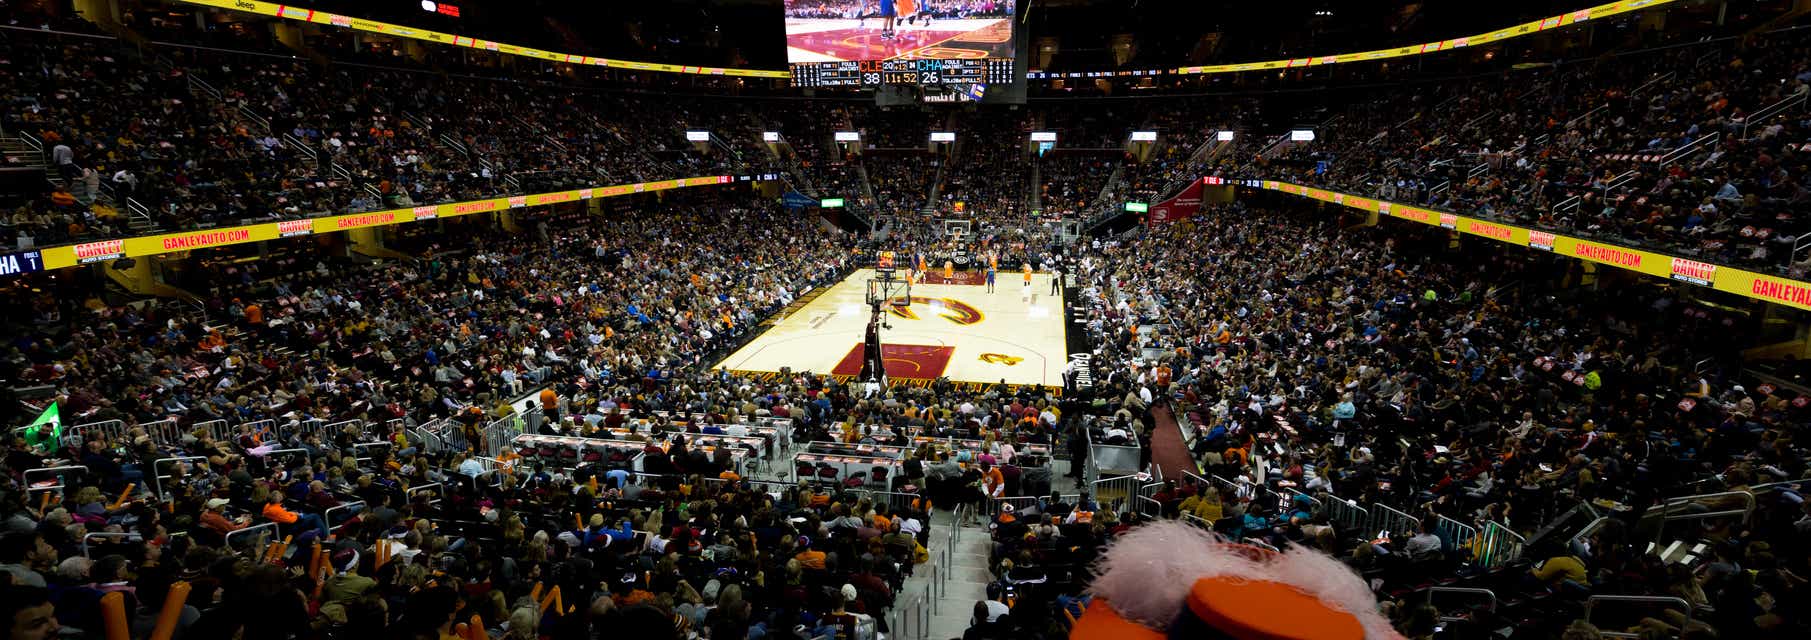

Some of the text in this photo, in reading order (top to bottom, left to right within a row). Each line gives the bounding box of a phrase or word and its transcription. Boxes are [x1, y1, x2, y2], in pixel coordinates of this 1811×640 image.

[235, 0, 255, 10] Jeep
[860, 60, 883, 72] CLE
[919, 60, 942, 71] CHA
[863, 73, 880, 84] 38
[885, 73, 917, 83] 11:52
[922, 72, 938, 83] 26
[279, 219, 311, 232] GANLEY
[338, 213, 394, 228] GANLEYAUTO.COM
[163, 230, 249, 249] GANLEYAUTO.COM
[1530, 231, 1555, 246] GANLEY
[76, 240, 122, 258] GANLEY
[1576, 243, 1641, 267] GANLEYAUTO.COM
[0, 255, 20, 275] HA
[30, 258, 36, 270] 1
[1673, 259, 1714, 280] GANLEY
